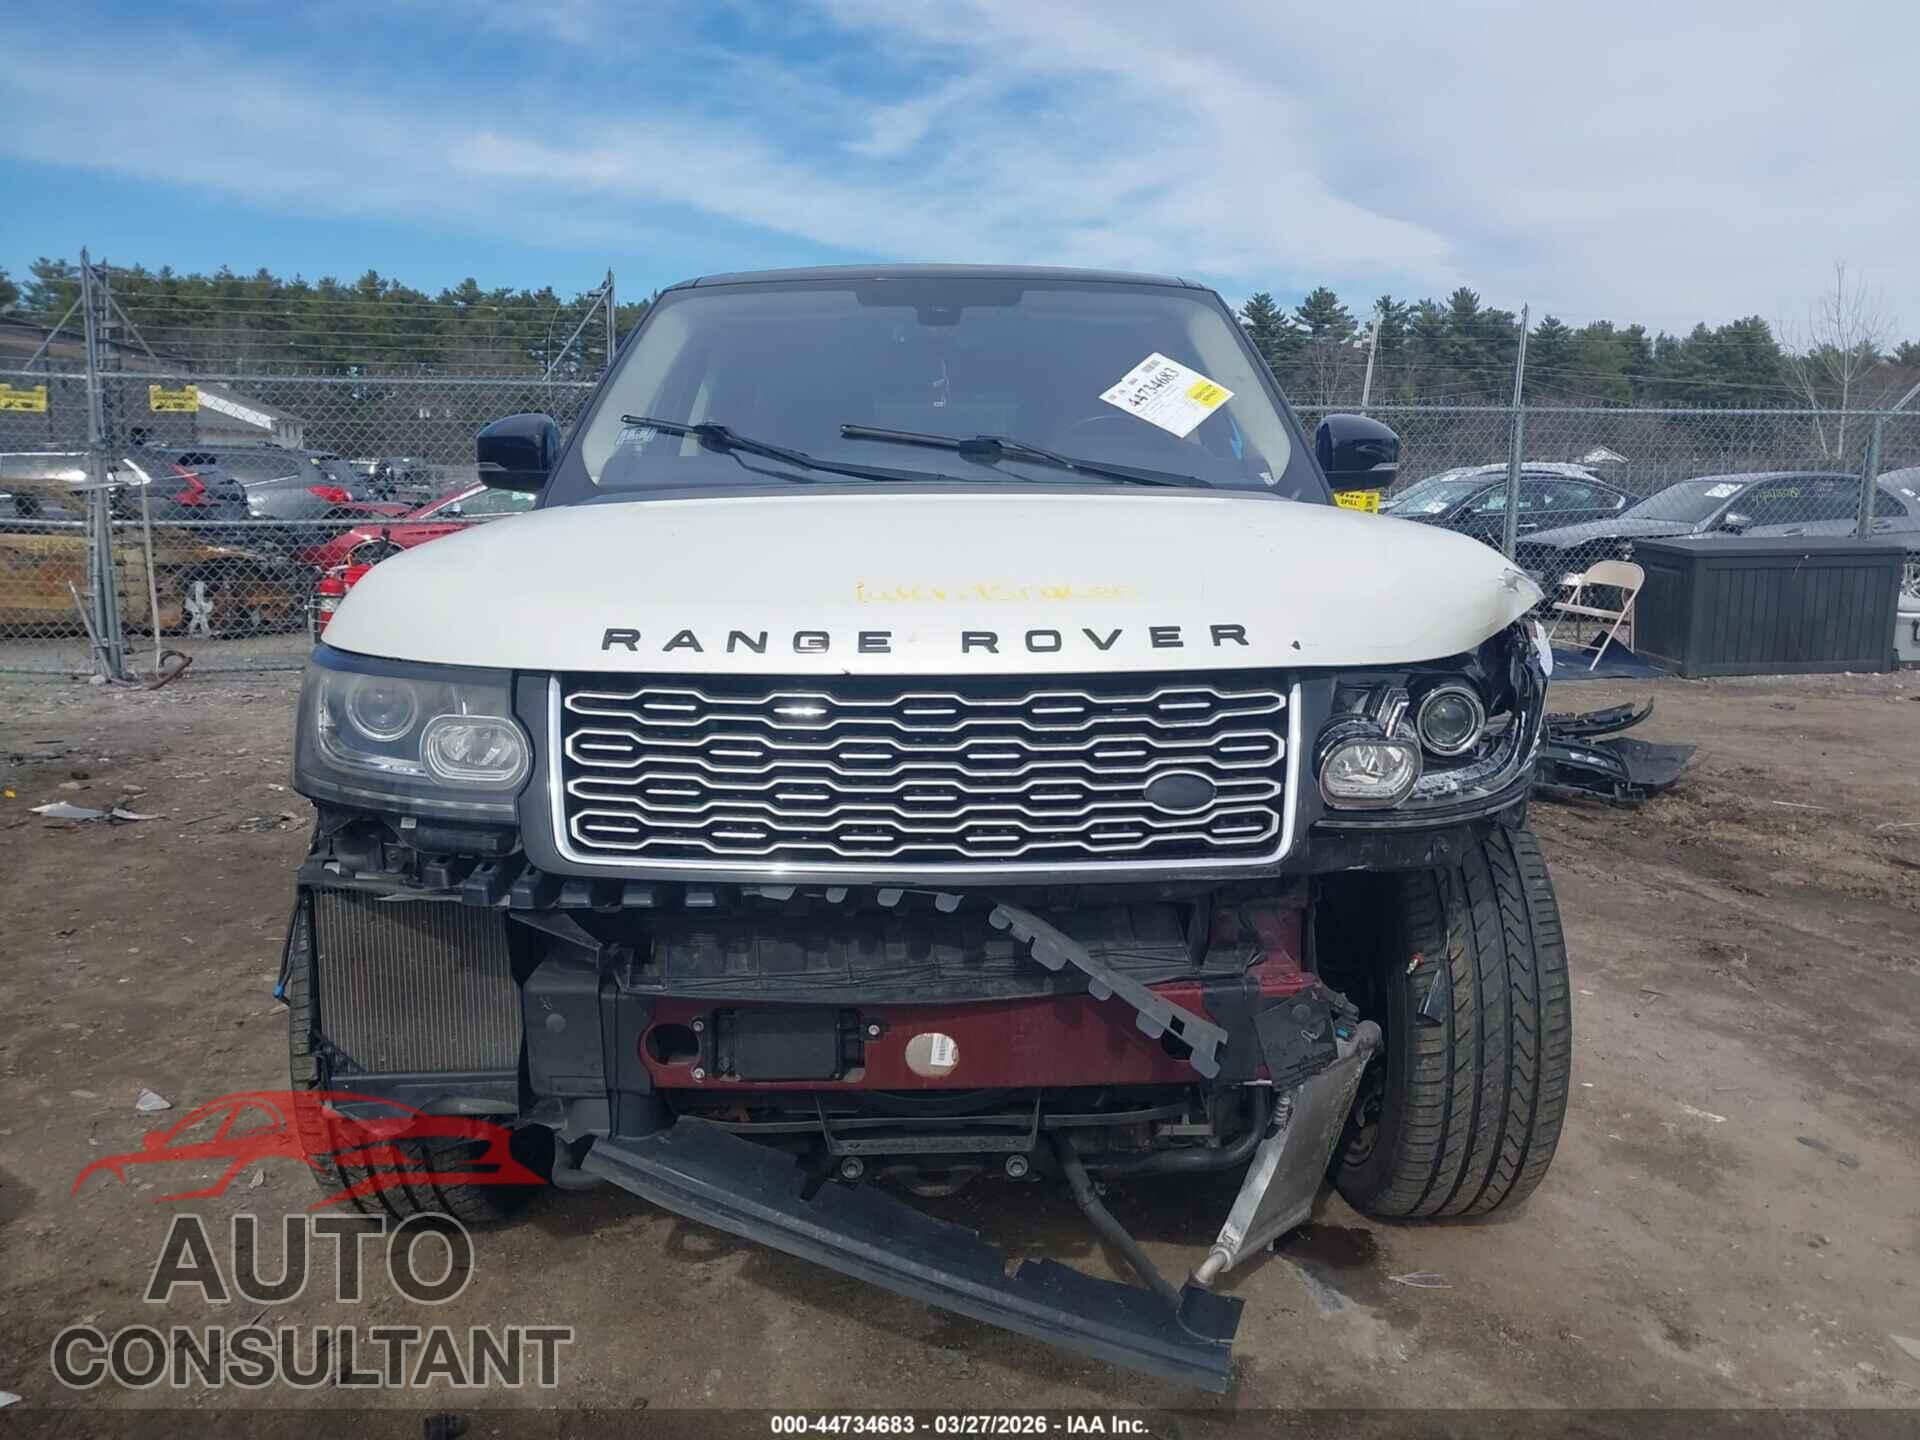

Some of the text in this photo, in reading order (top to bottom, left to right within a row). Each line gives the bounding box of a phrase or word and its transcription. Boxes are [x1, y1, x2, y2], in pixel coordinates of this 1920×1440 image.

[1128, 367, 1180, 408] 44734683
[601, 624, 1250, 654] RANGE ROVER
